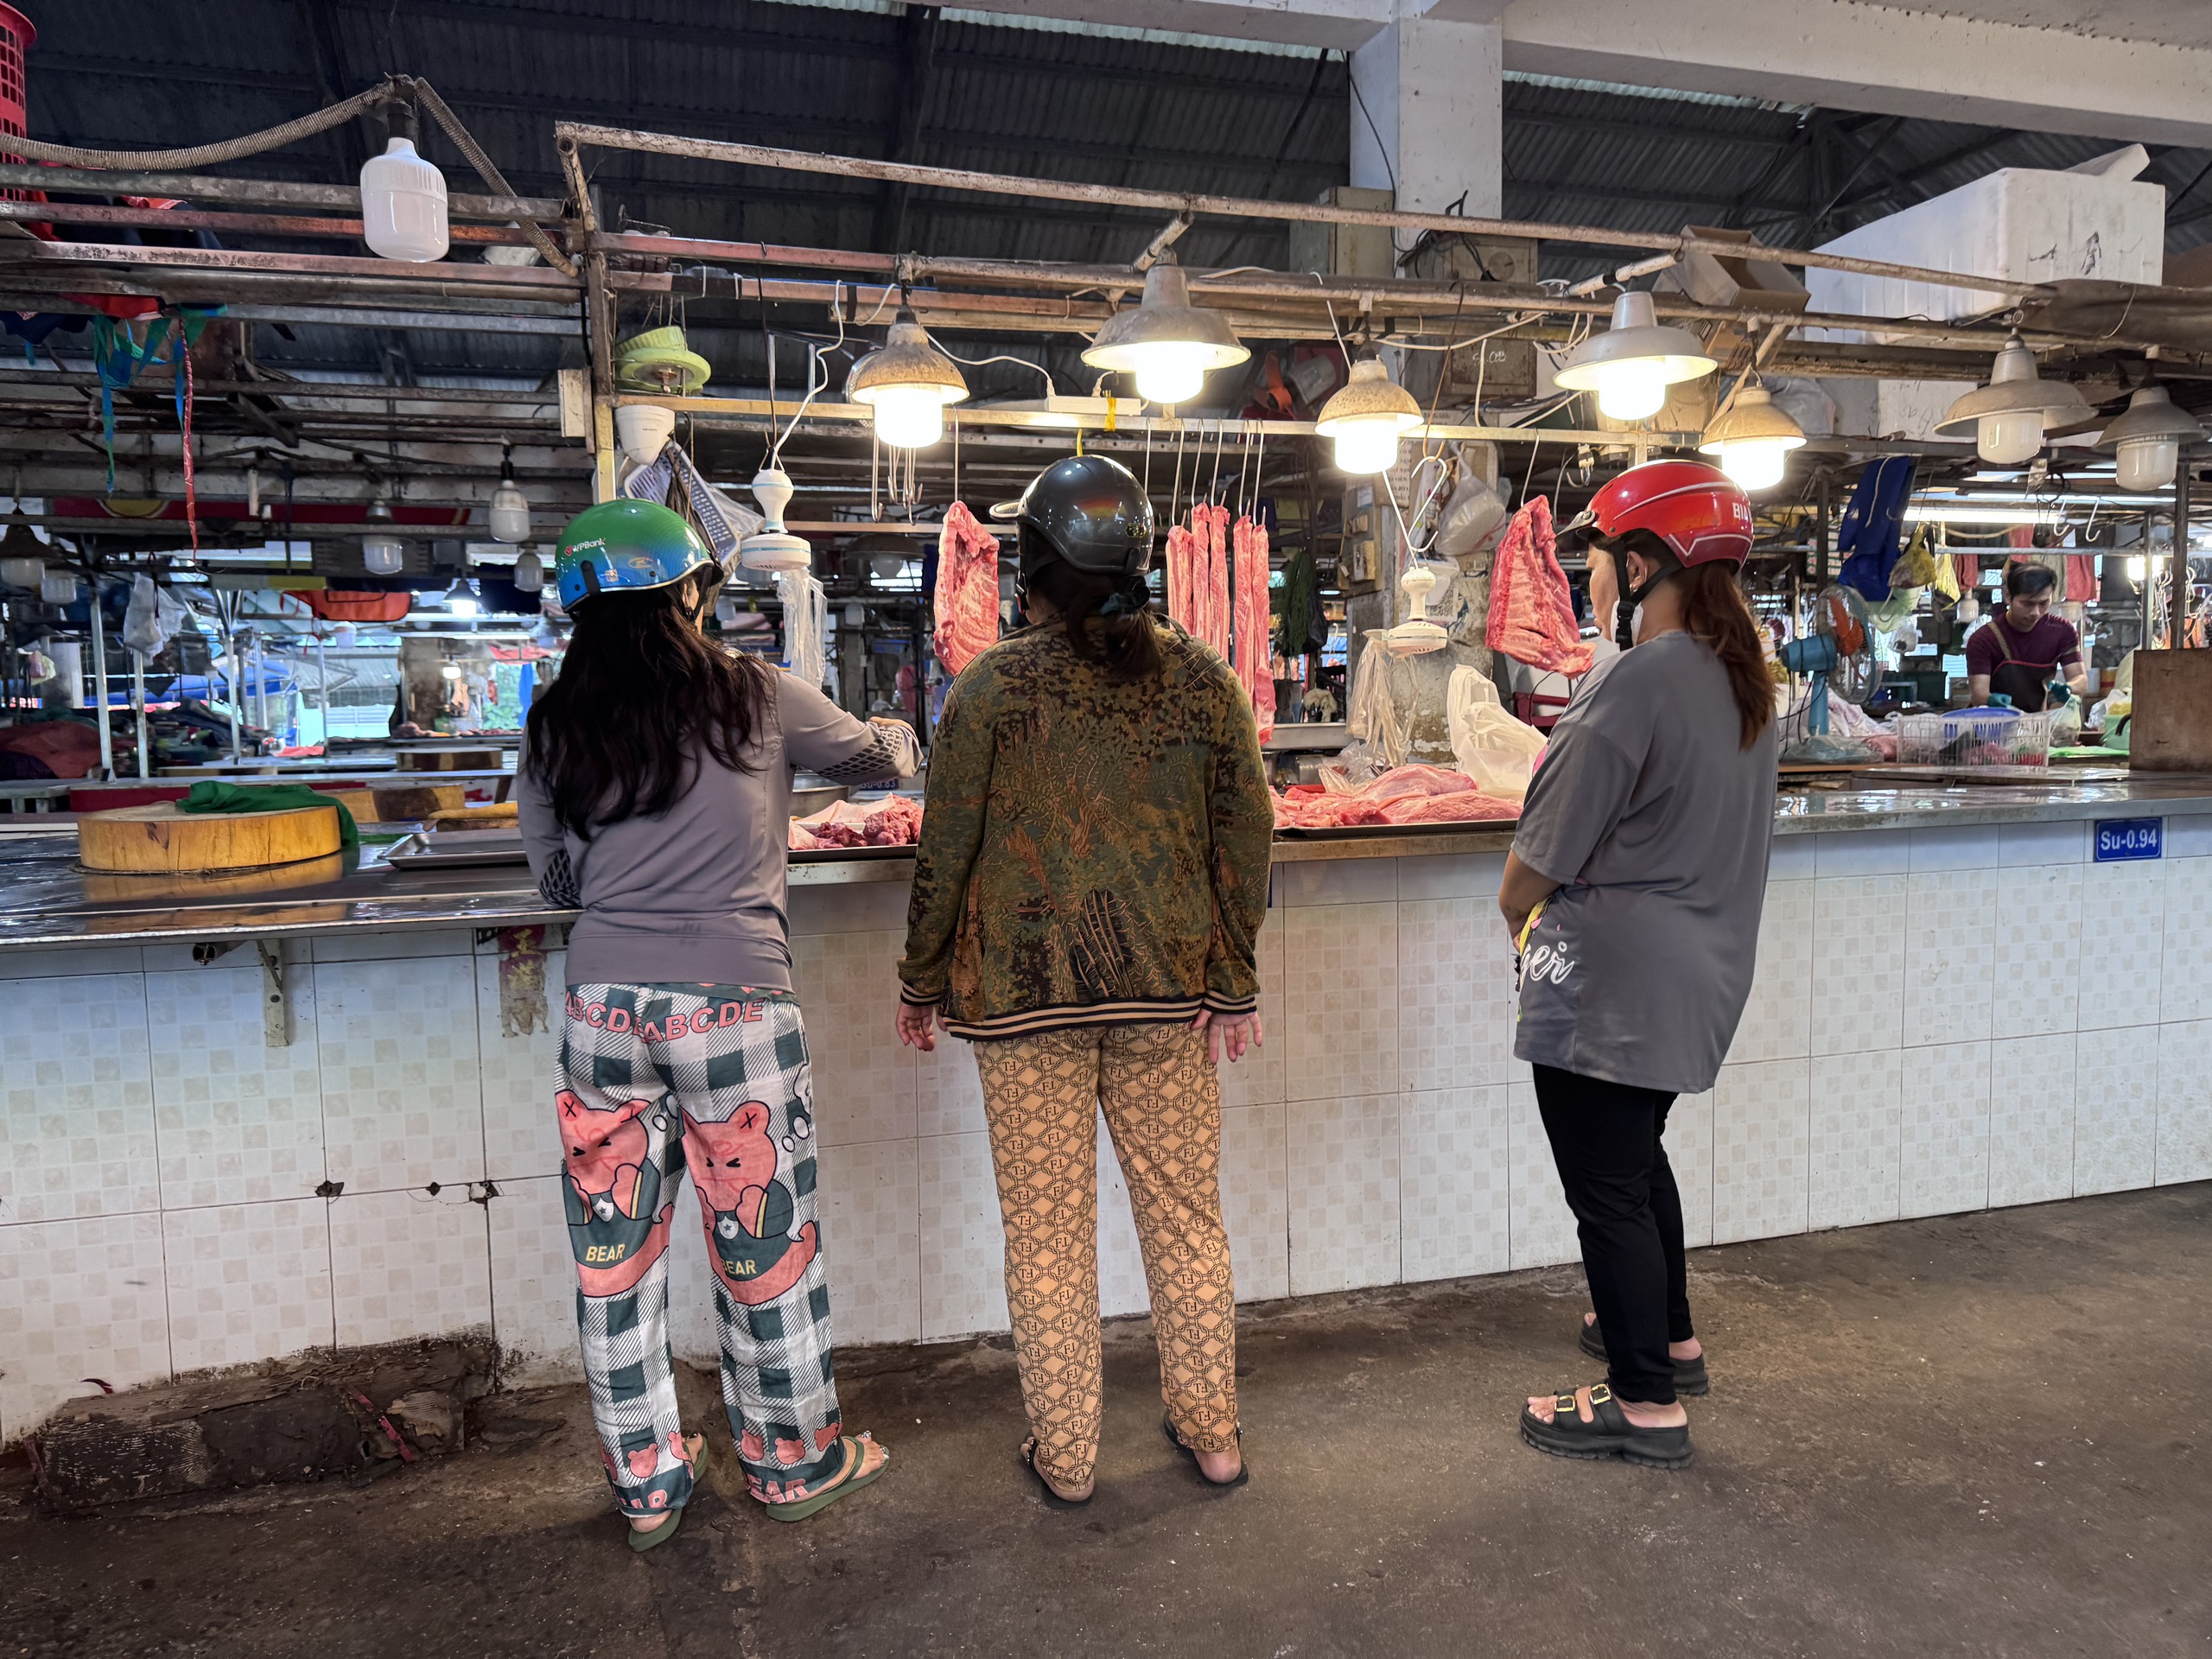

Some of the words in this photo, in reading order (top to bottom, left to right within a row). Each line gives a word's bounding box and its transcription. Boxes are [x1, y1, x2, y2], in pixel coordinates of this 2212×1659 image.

[2101, 828, 2158, 850] Su-0.94
[644, 997, 764, 1043] ABCDE
[586, 1243, 626, 1262] BEAR
[742, 1471, 809, 1504] EAR
